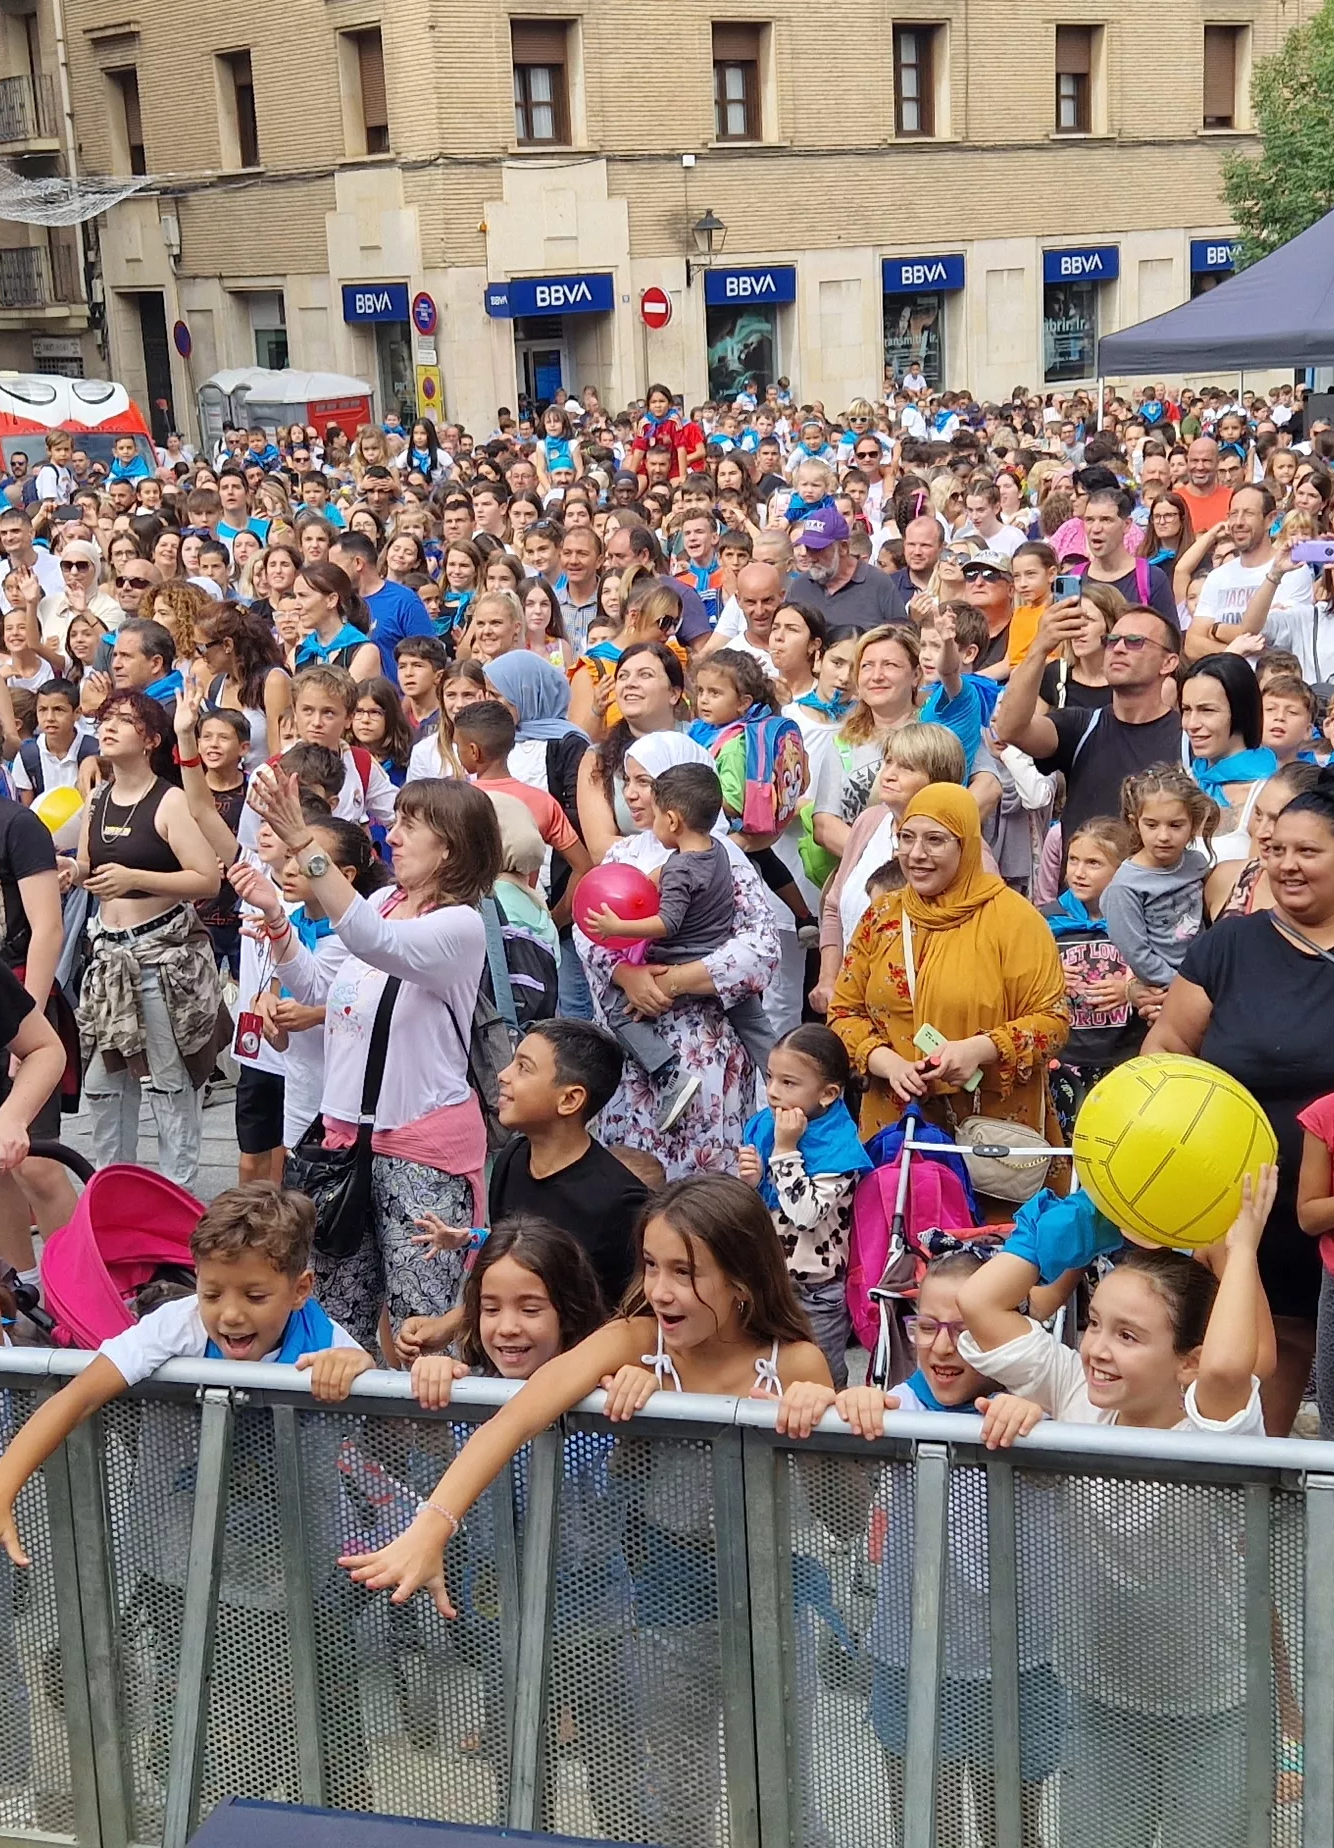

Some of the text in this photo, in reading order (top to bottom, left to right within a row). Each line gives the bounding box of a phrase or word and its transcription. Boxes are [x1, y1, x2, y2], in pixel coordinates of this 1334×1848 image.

[901, 262, 947, 285] BBVA
[1061, 253, 1103, 275] BBVA
[536, 281, 592, 307] BBVA
[726, 273, 776, 297] BBVA
[355, 291, 393, 314] BBVA
[490, 295, 508, 306] BBVA
